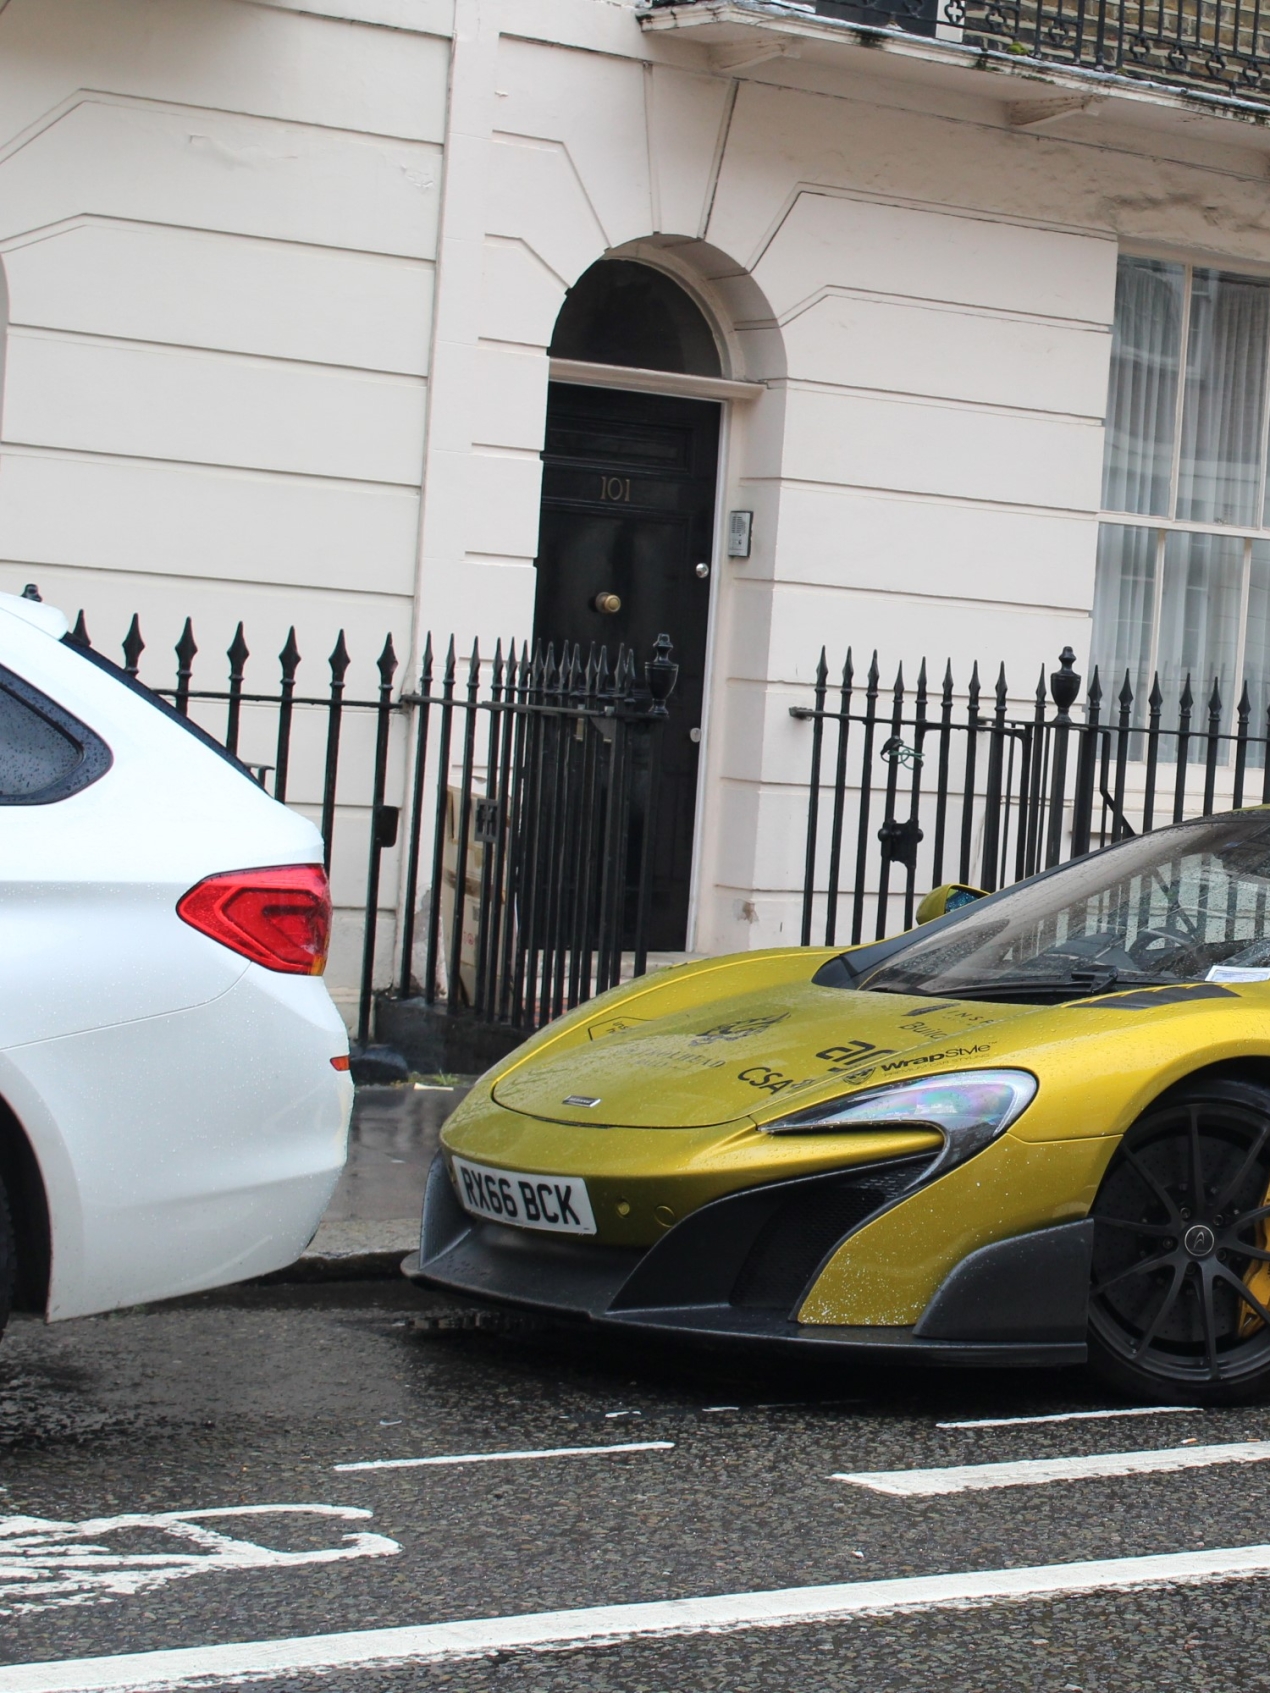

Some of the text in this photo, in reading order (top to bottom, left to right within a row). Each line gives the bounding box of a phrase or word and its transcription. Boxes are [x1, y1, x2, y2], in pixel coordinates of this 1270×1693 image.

[600, 476, 630, 502] 101
[737, 1066, 794, 1095] CSA
[460, 1166, 581, 1225] RX66 BCK
